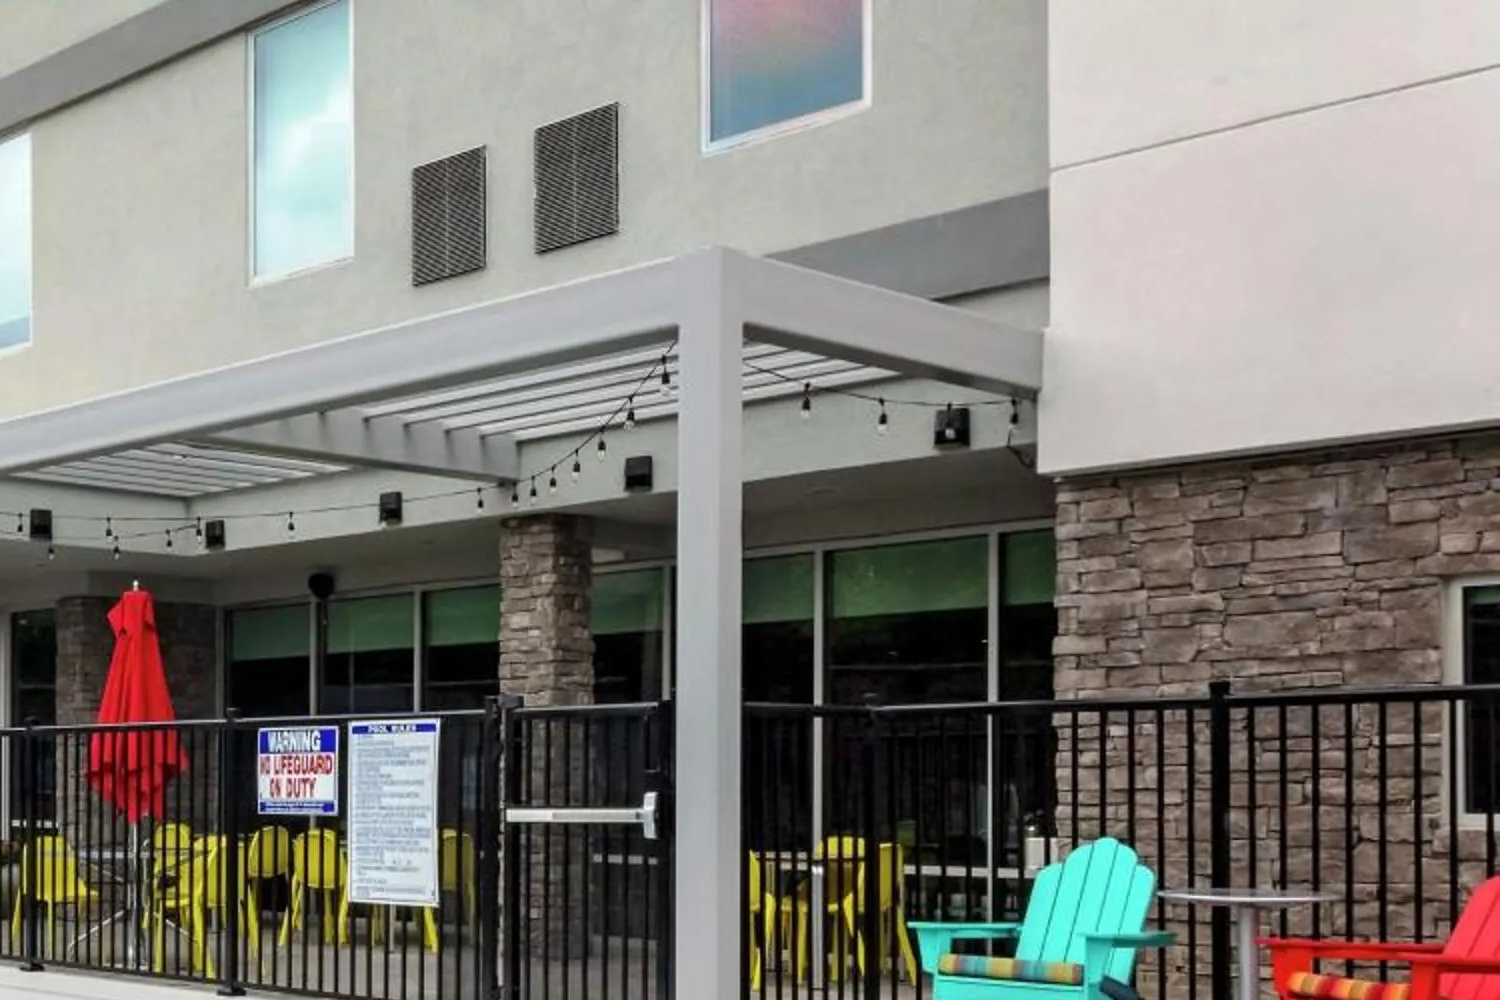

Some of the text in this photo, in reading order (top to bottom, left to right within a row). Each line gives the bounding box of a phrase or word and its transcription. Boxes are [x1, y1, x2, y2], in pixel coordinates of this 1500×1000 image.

[267, 730, 321, 753] WARNING
[260, 755, 332, 774] NO LIFEGUARD
[270, 778, 317, 797] ON DUTY
